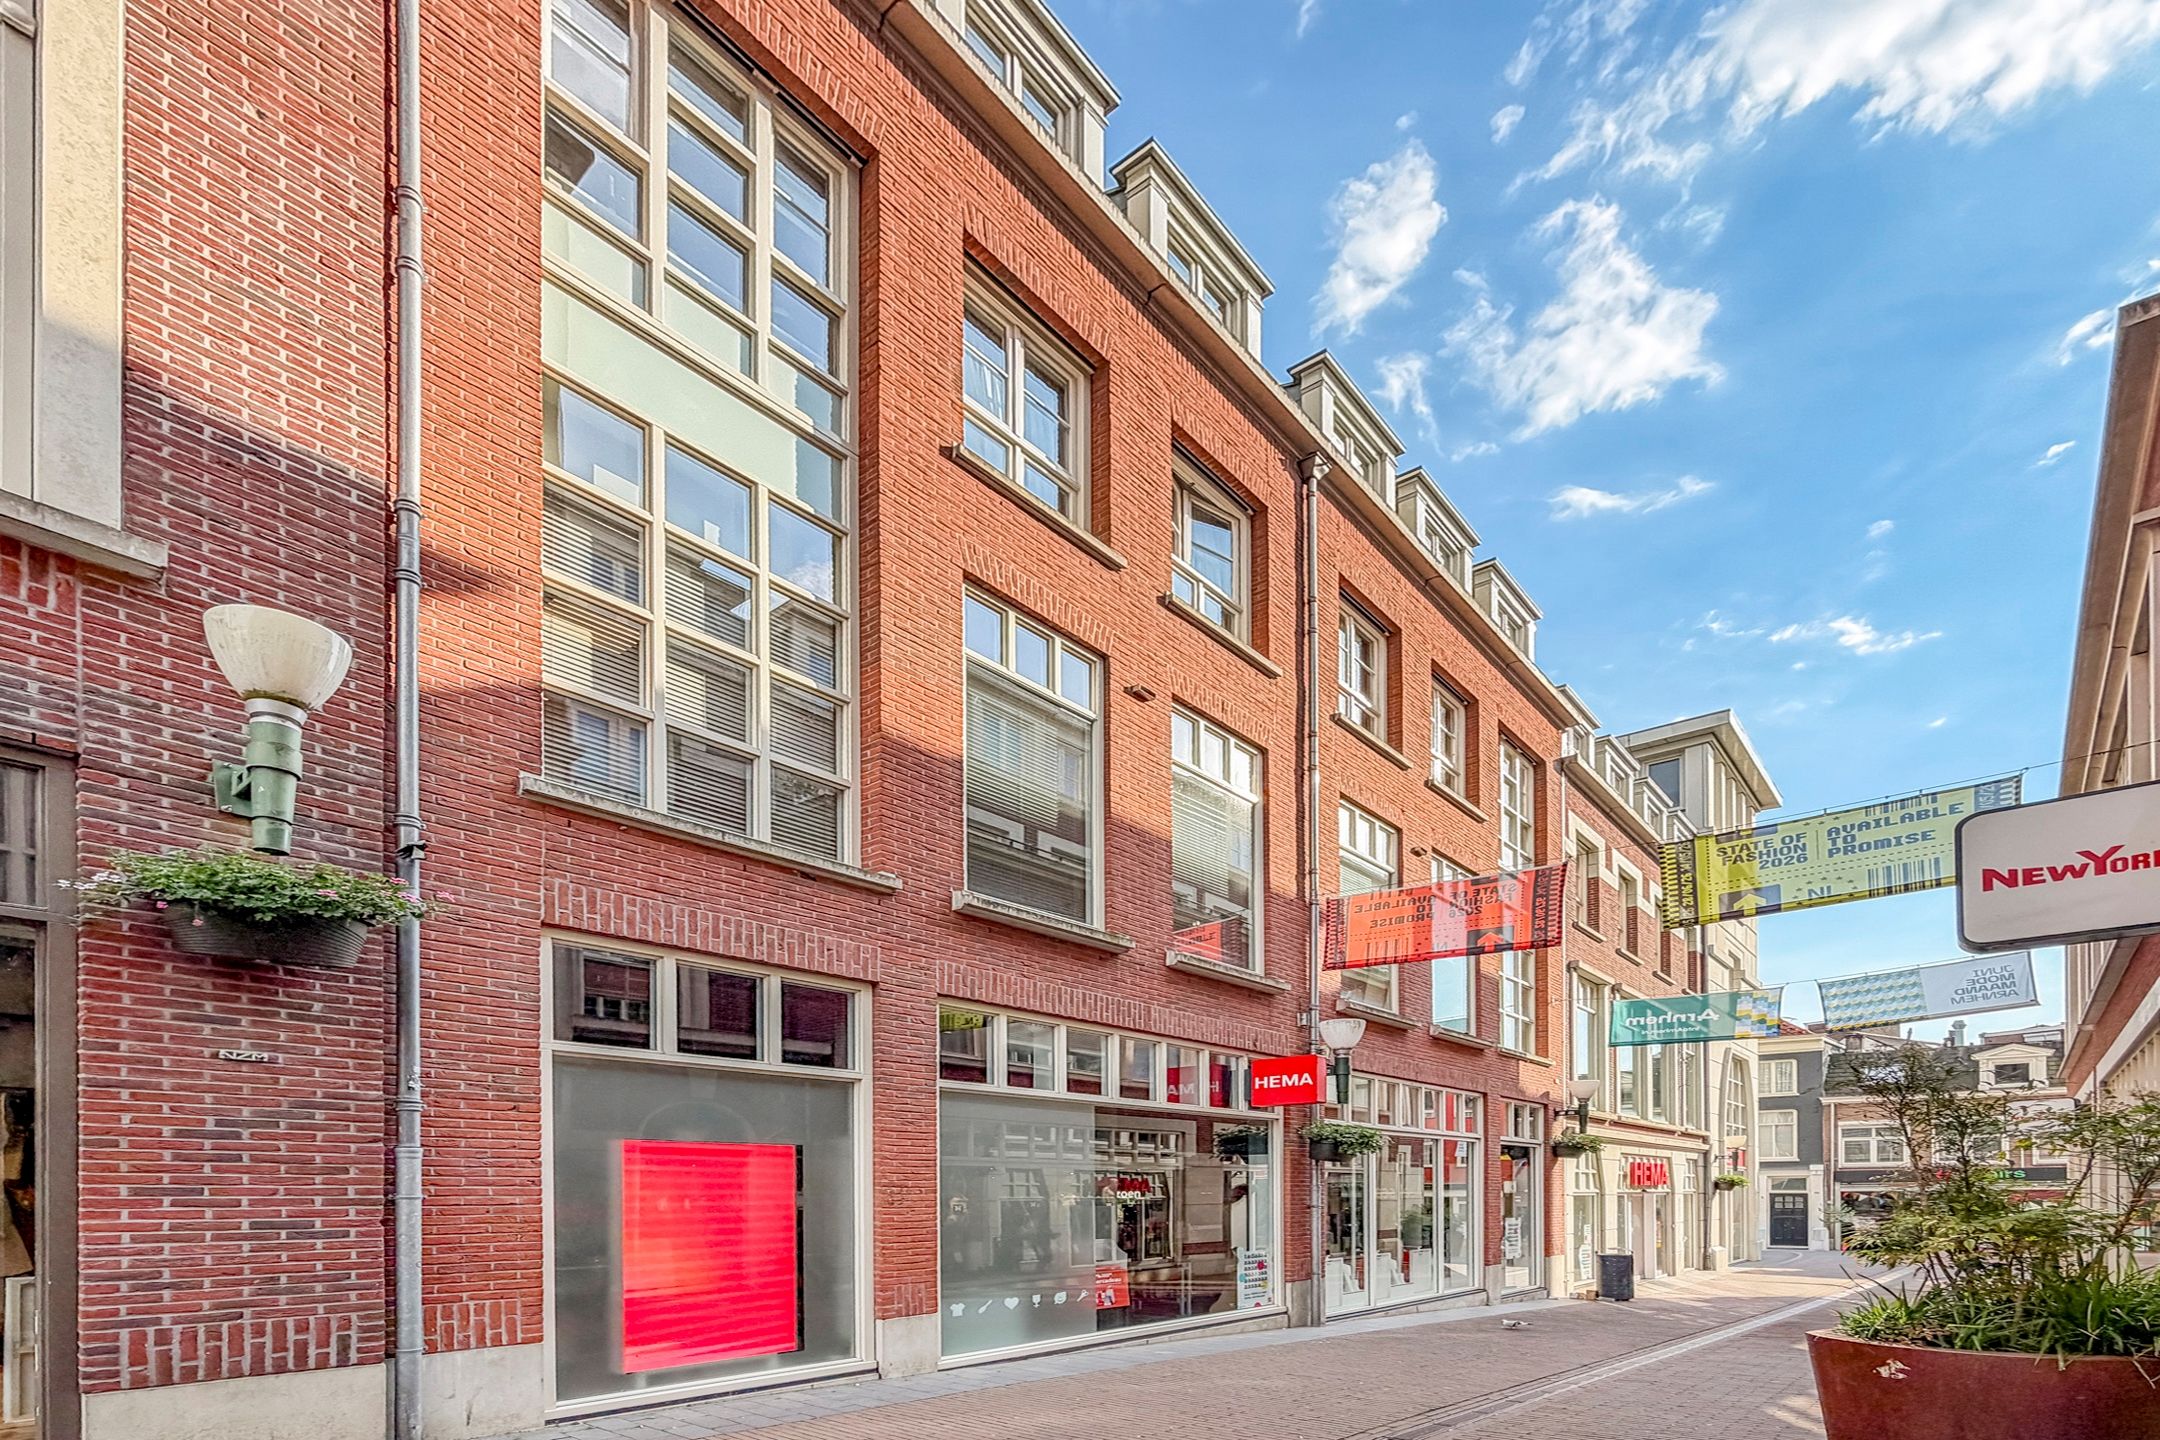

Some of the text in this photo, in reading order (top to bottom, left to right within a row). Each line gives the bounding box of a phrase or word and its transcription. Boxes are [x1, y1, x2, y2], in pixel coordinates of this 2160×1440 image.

[1826, 802, 1964, 837] AVAILABLE
[1716, 832, 1808, 858] STATE OF
[1827, 834, 1857, 847] TO
[1827, 830, 1937, 858] PROMISE
[1722, 843, 1808, 866] FASHION
[1758, 853, 1808, 870] 2026
[1254, 1073, 1313, 1089] HEMA
[1632, 1162, 1669, 1186] HEMA
